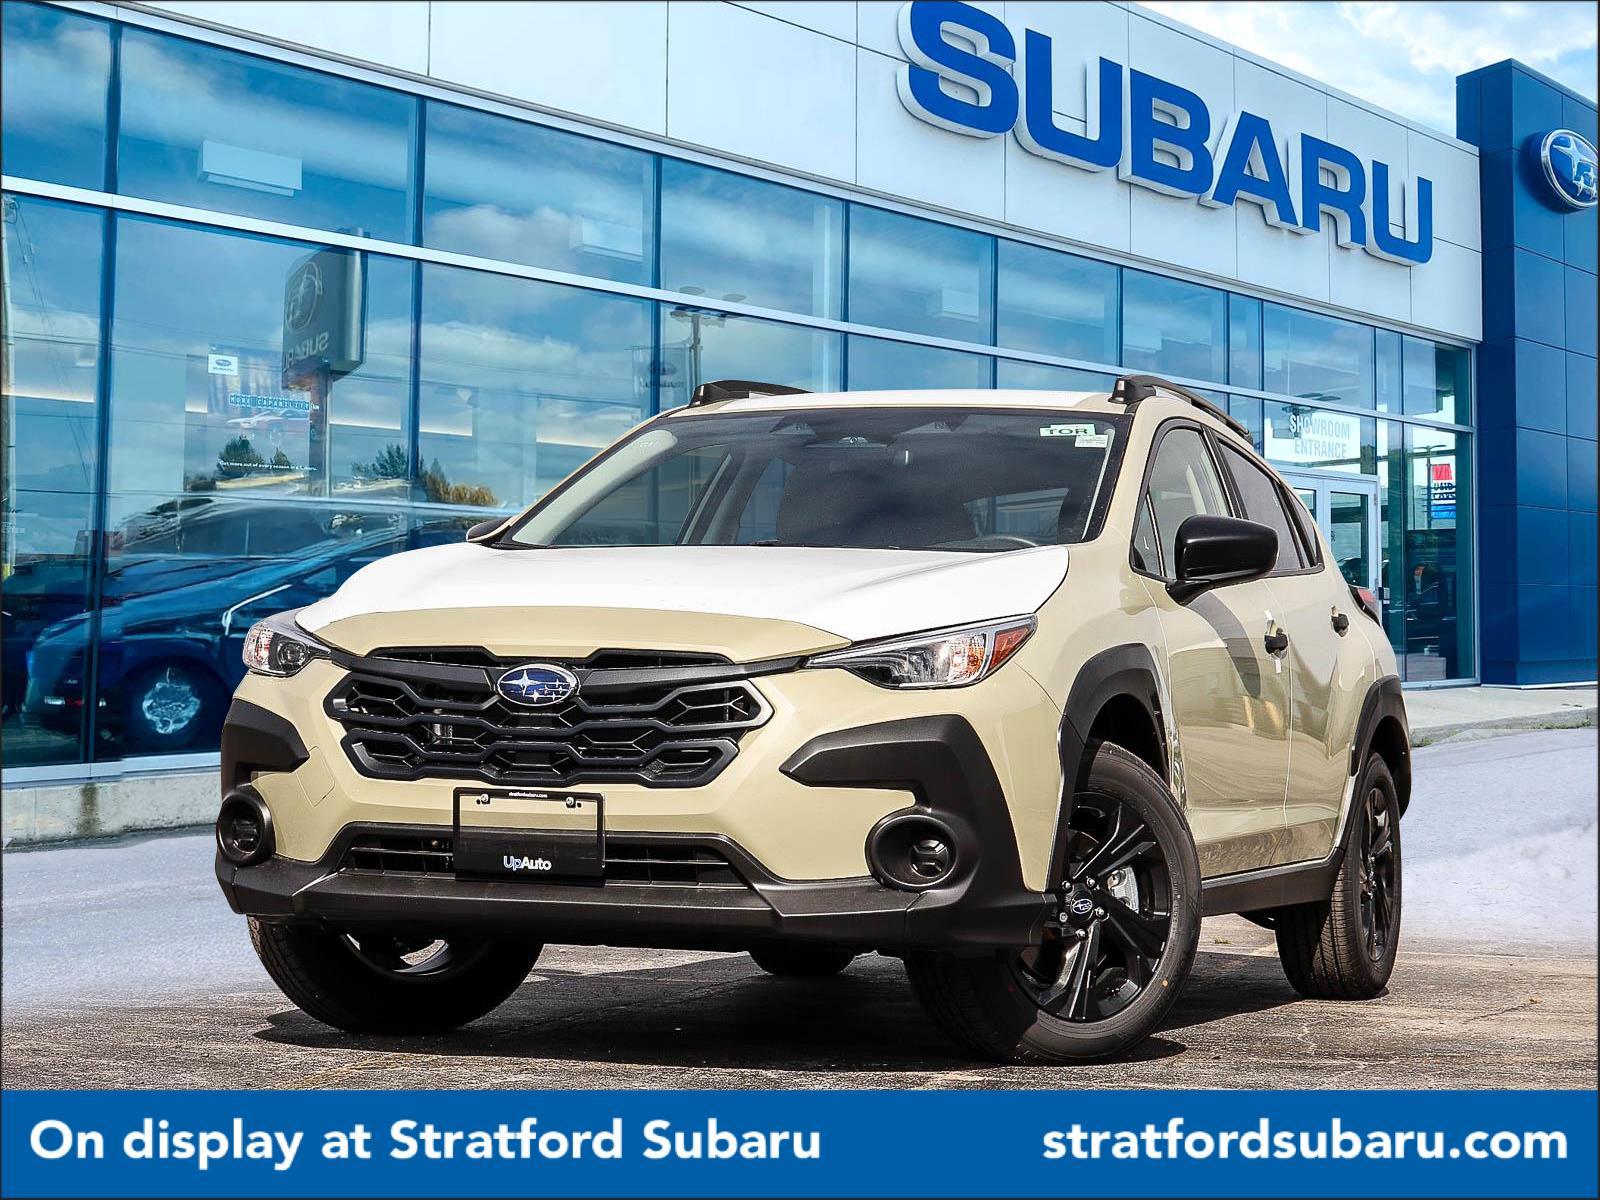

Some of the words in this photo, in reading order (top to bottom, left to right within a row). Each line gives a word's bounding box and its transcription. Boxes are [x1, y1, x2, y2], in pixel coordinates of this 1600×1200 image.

[898, 1, 1433, 265] SUBARU
[1290, 414, 1351, 440] SHOWROOM
[1294, 438, 1347, 459] ENTRANCE
[503, 855, 552, 871] UpAuto
